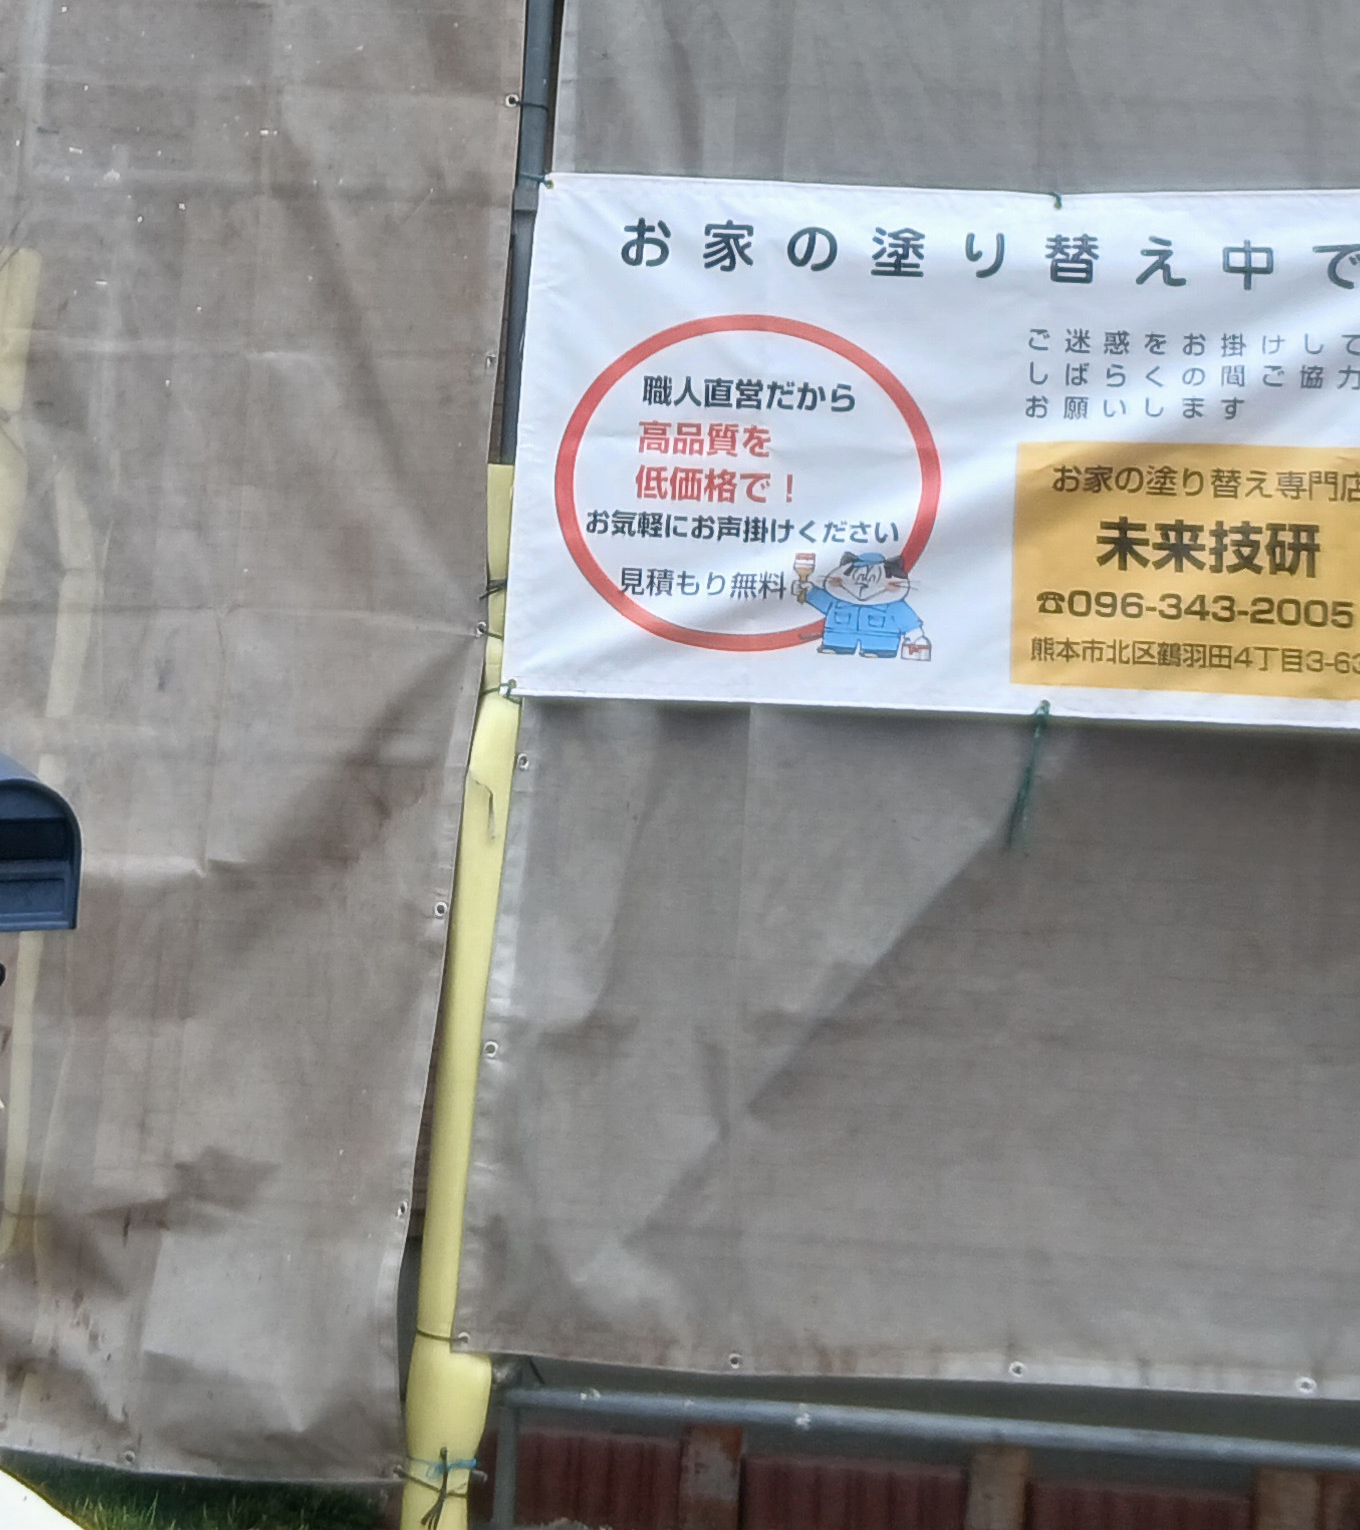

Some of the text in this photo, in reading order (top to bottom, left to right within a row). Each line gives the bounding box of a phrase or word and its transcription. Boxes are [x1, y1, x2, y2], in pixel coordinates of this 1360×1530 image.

[642, 375, 856, 412] 職人直営だから
[1024, 394, 1246, 421] お願いします
[638, 420, 772, 458] 高品質を
[635, 464, 794, 504] 低価格で！
[585, 509, 900, 544] お気軽にお声掛けください
[1095, 515, 1322, 579] 未来技研
[620, 566, 787, 601] 見積もり無料
[1067, 589, 1357, 630] 096-343-2005
